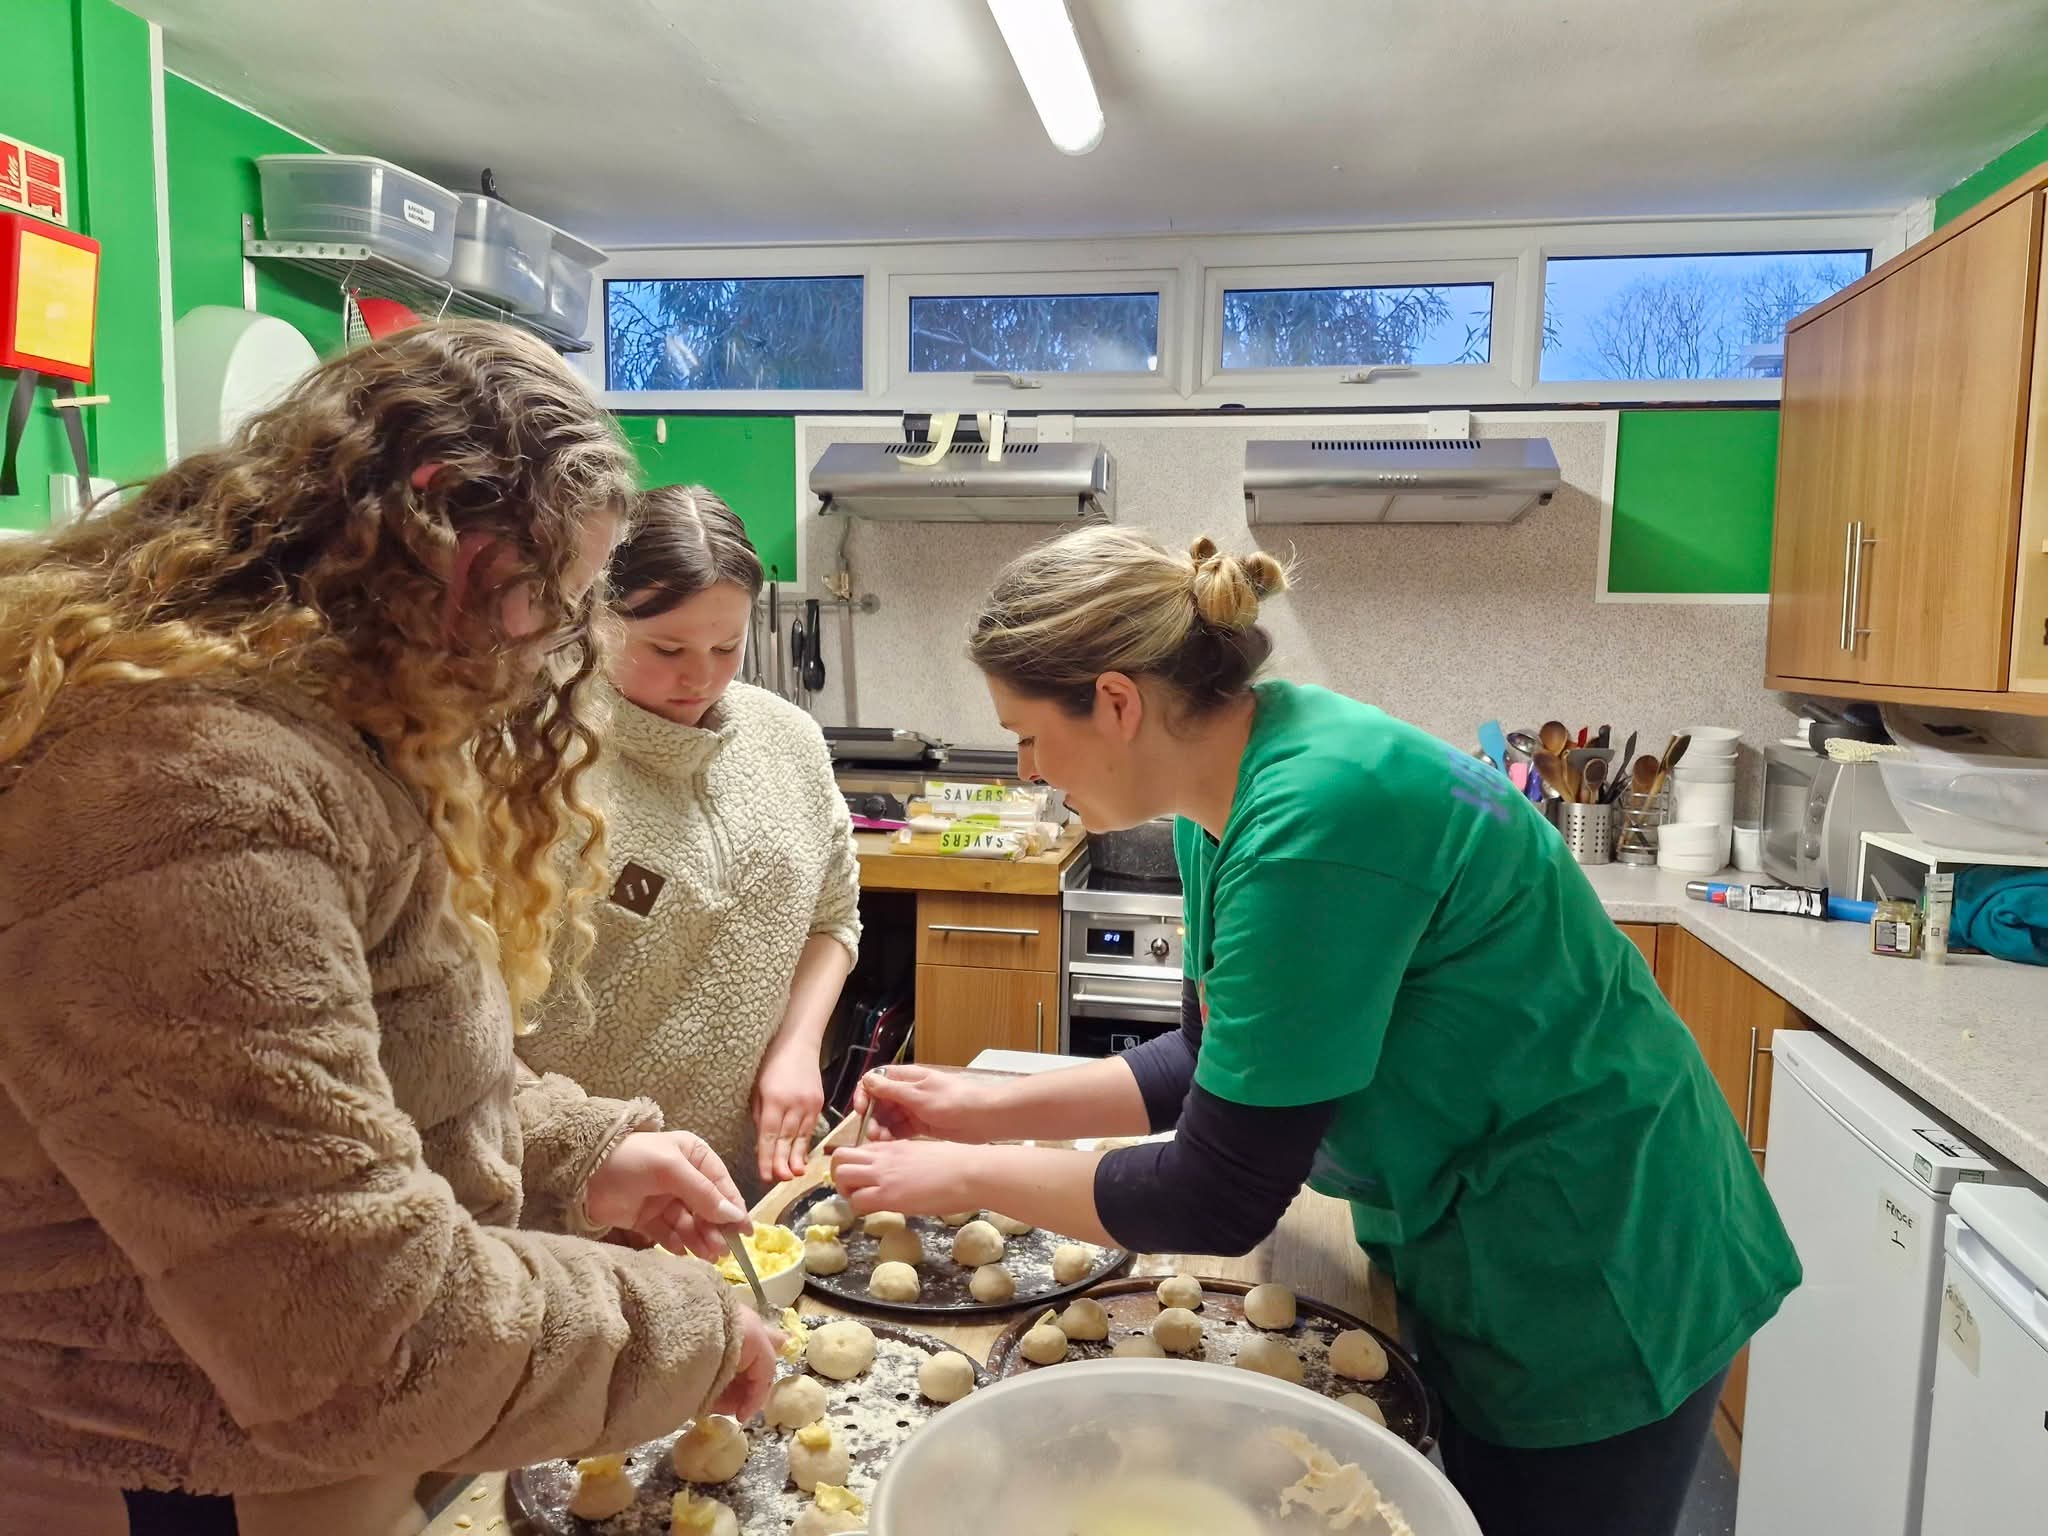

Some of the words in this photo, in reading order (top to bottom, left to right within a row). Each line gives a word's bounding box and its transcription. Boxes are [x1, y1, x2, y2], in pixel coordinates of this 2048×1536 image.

[944, 788, 1004, 802] SAVERS
[942, 833, 1004, 848] SAVERS
[1886, 1199, 1913, 1229] FRIDGE
[1890, 1230, 1906, 1250] 1
[1952, 1313, 1966, 1345] 2
